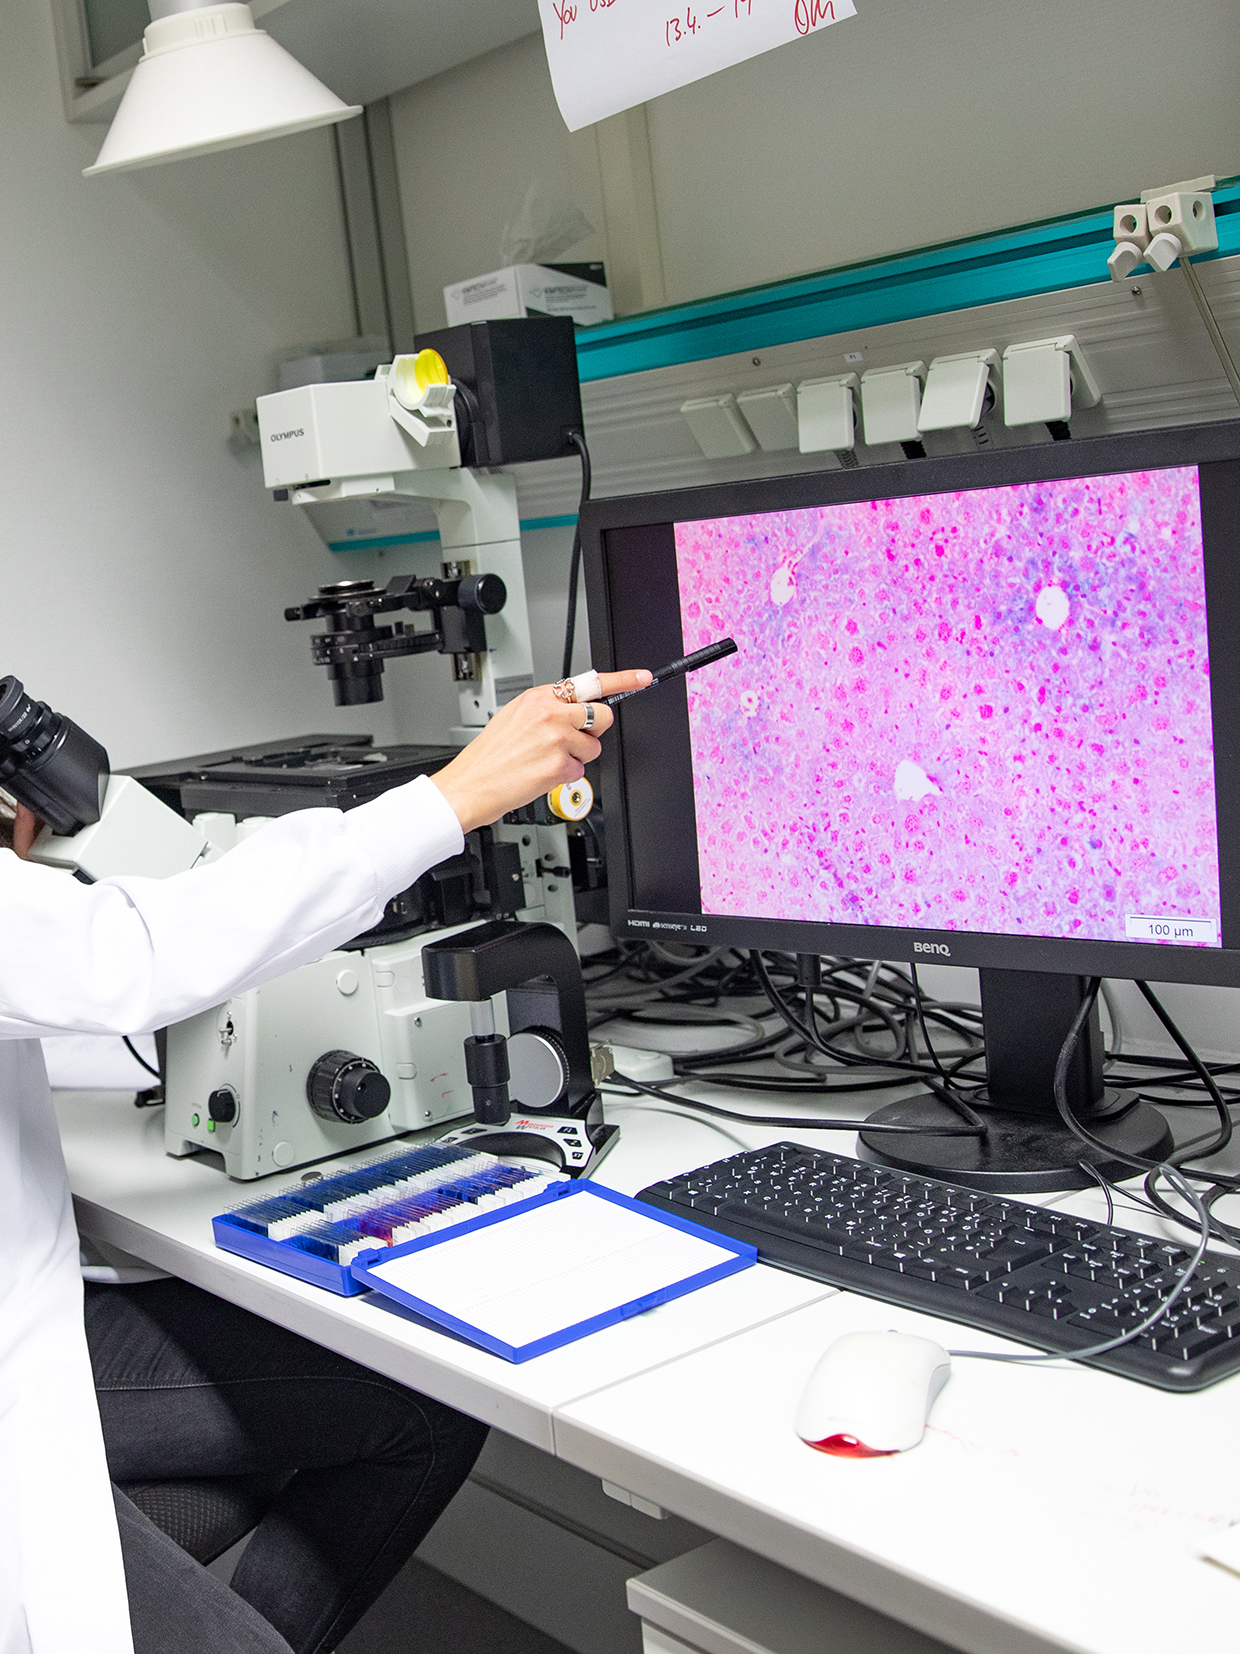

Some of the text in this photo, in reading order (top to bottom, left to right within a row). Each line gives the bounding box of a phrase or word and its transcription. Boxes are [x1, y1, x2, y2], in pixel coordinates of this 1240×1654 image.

[666, 7, 701, 46] 13.4.
[270, 428, 305, 442] OLYMPUS
[627, 919, 650, 927] HDMI
[690, 924, 708, 932] LED
[1148, 924, 1170, 935] 100
[913, 941, 951, 957] BenQ
